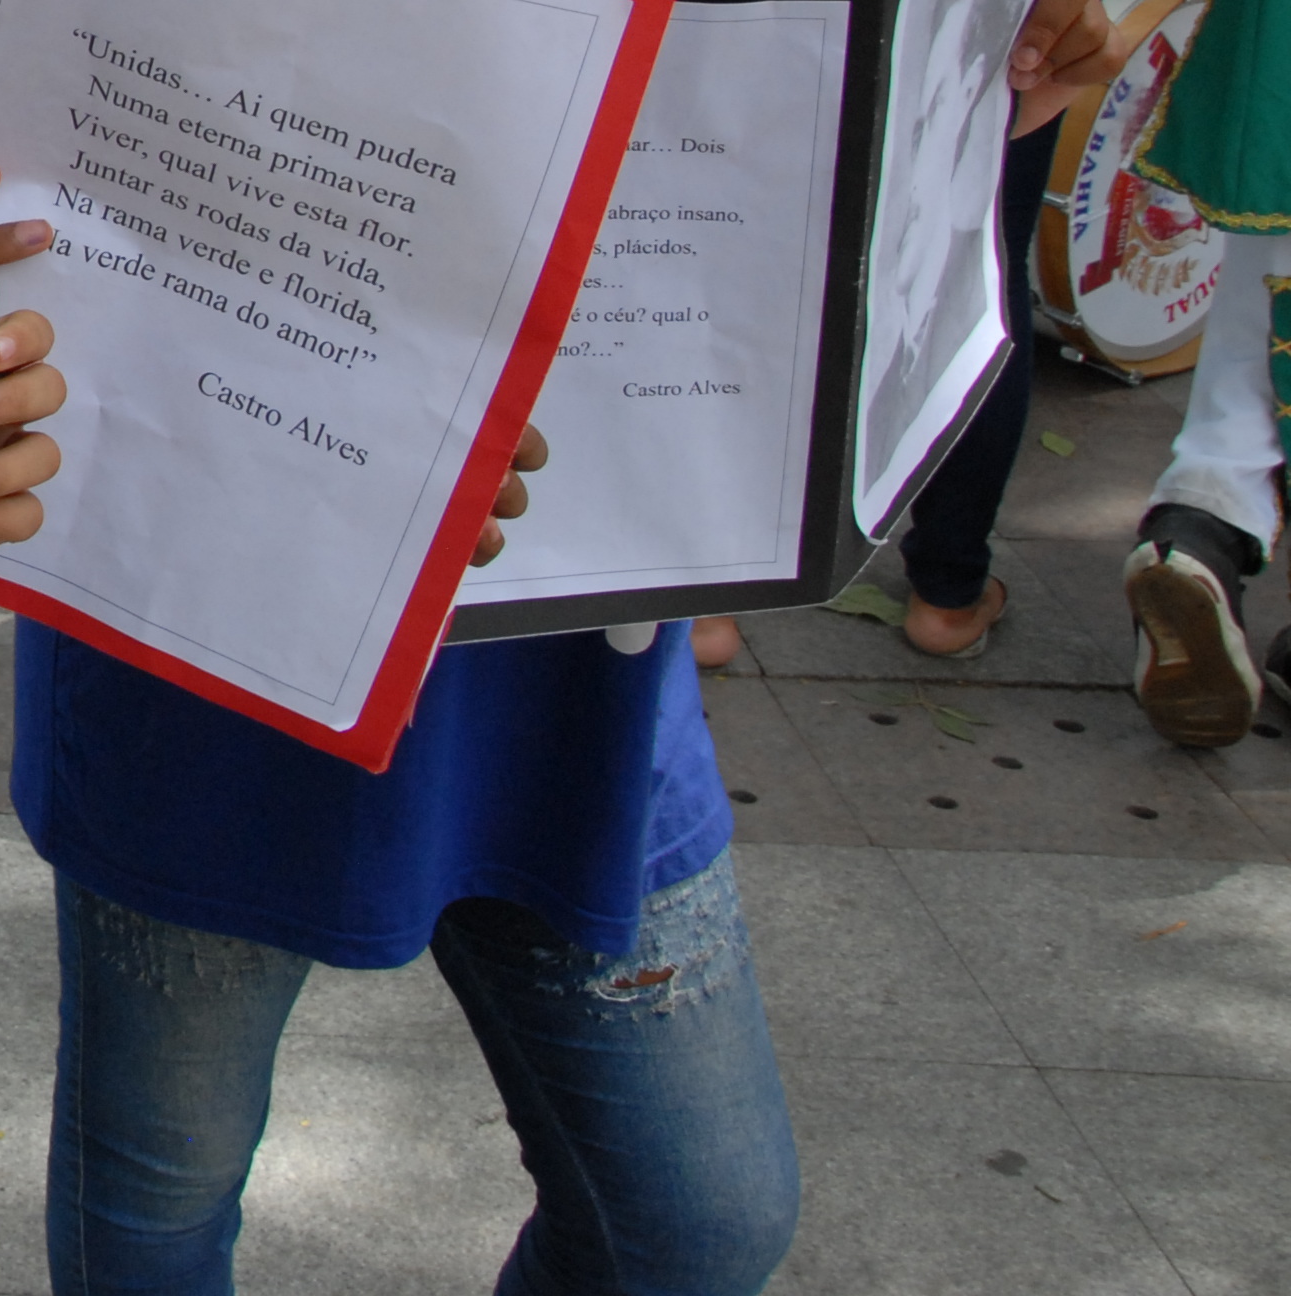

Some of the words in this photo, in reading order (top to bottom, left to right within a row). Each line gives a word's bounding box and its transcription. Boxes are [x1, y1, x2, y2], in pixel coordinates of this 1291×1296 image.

[224, 88, 265, 119] Ai
[269, 104, 350, 149] quem
[356, 135, 458, 186] pudera
[1099, 76, 1132, 120] DA
[67, 107, 149, 160] Viver,
[158, 148, 217, 184] qual
[226, 173, 286, 209] vive
[293, 202, 348, 231] esta
[358, 217, 415, 258] flor.
[87, 75, 169, 126] Numa
[178, 117, 262, 162] eterna
[268, 149, 417, 214] primavera
[680, 138, 726, 154] Dois
[1073, 133, 1106, 243] BAHIA
[53, 183, 94, 216] Na
[101, 205, 168, 244] rama
[177, 235, 251, 275] verde
[258, 266, 276, 286] e
[283, 273, 380, 335] florida,
[69, 149, 155, 196] Juntar
[160, 186, 189, 211] as
[196, 202, 271, 244] rodas
[278, 230, 312, 259] da
[322, 248, 387, 293] vida,
[607, 205, 671, 223] abraço
[677, 205, 745, 225] insano,
[613, 239, 698, 259] plácidos,
[83, 244, 157, 282] verde
[161, 271, 229, 314] rama
[236, 300, 270, 331] do
[571, 307, 582, 322] é
[586, 311, 598, 322] o
[604, 307, 646, 323] céu?
[652, 307, 692, 326] qual
[697, 310, 709, 322] o
[197, 371, 284, 427] Castro
[288, 415, 370, 467] Alves
[622, 382, 682, 398] Castro
[687, 380, 742, 396] Alves
